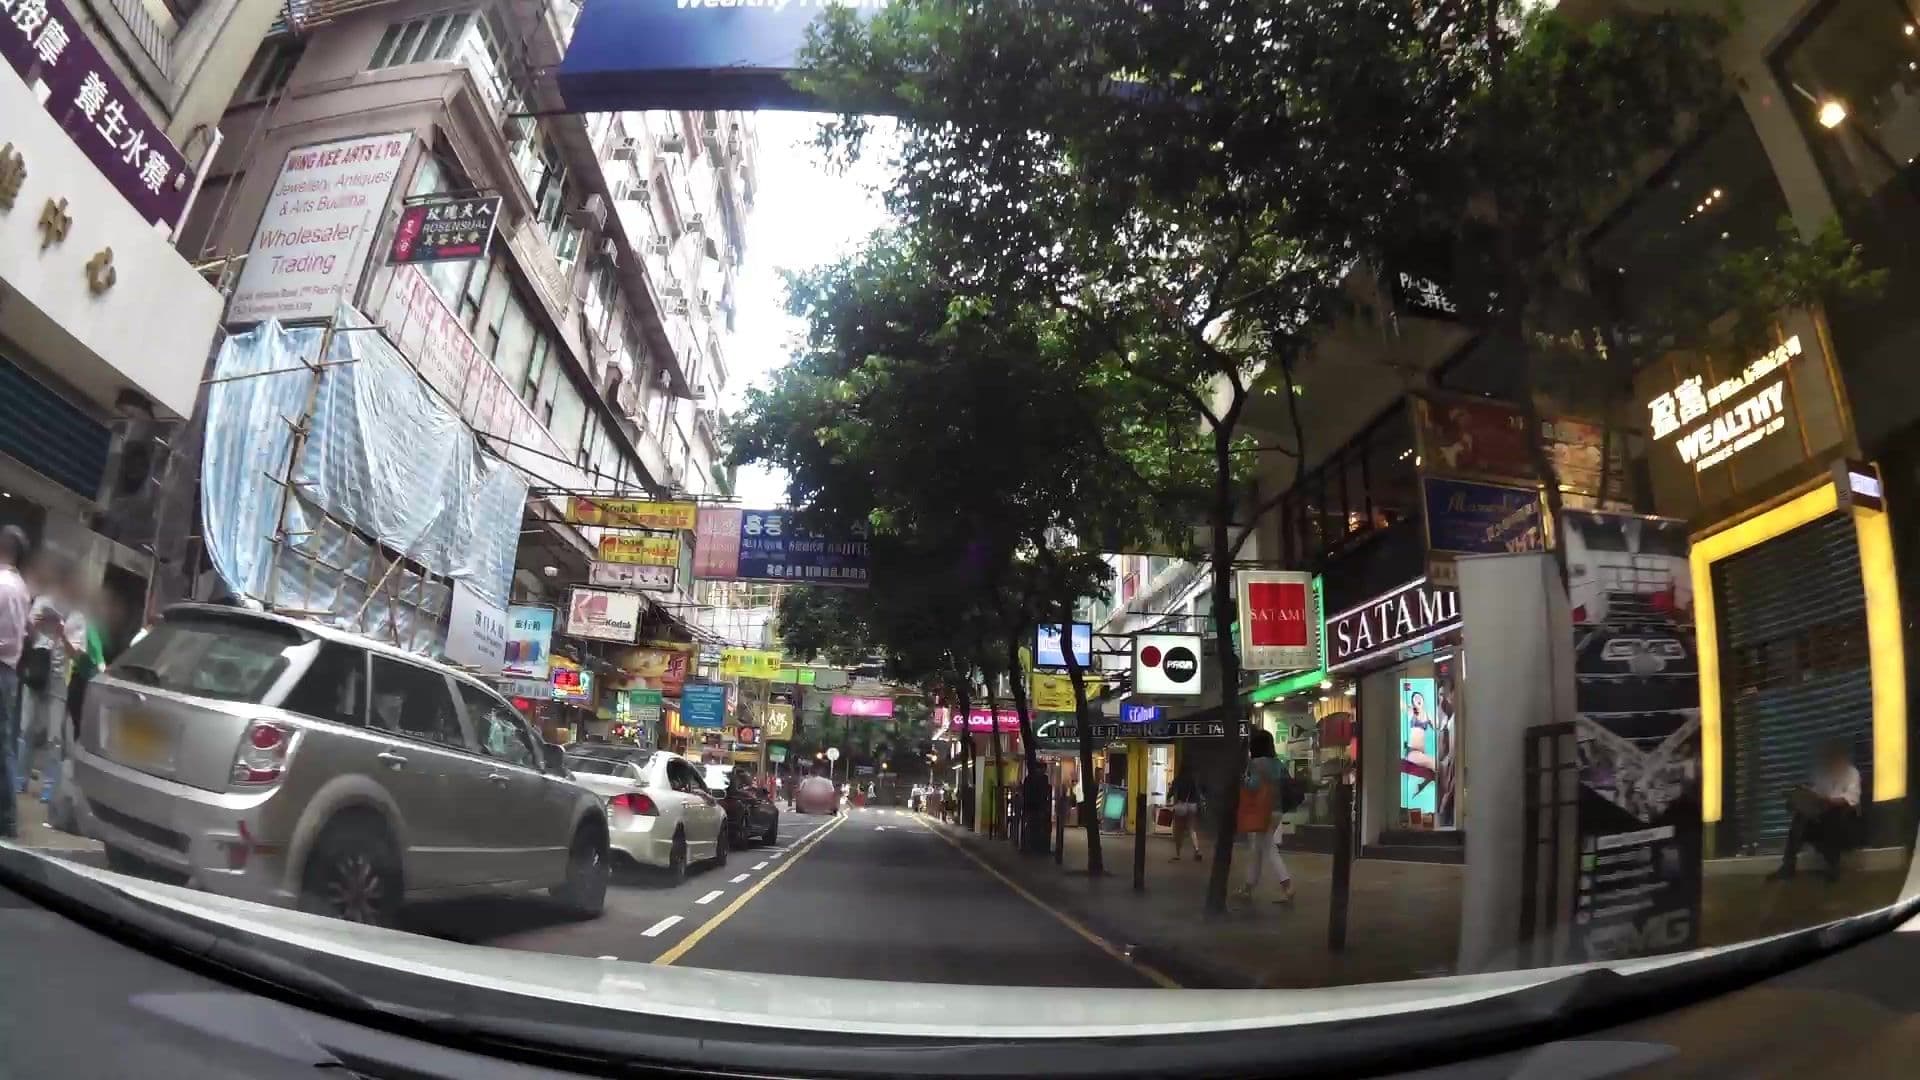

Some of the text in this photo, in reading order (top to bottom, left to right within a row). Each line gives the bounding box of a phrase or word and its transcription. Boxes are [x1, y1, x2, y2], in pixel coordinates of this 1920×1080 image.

[259, 222, 359, 249] Wholesaler
[271, 252, 337, 276] Trading
[1675, 380, 1784, 464] WEALTHY
[602, 502, 637, 514] Kodak
[605, 618, 632, 630] Kodak
[1249, 607, 1305, 622] SATAMI
[1338, 587, 1459, 657] SATAMI
[1176, 722, 1201, 736] LEE
